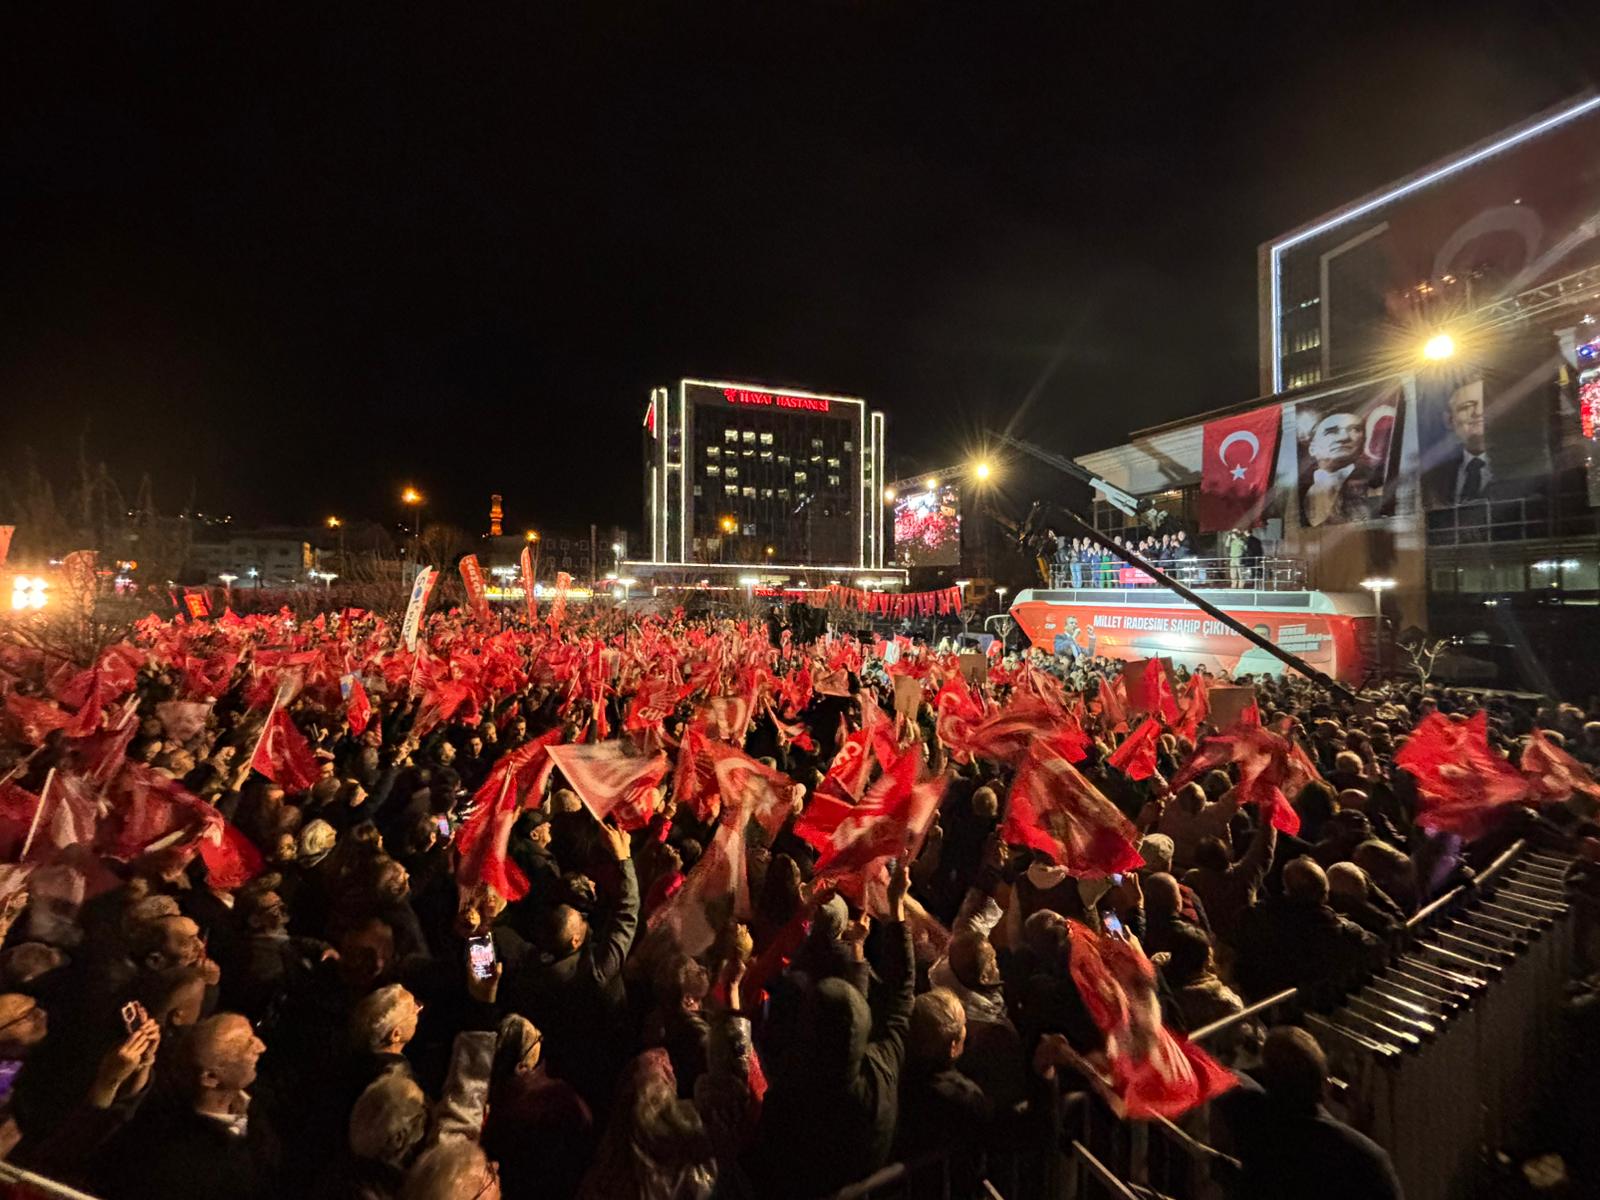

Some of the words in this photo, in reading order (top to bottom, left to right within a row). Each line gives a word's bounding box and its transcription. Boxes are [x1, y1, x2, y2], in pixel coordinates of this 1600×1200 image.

[1093, 615, 1122, 628] MİLLET
[1123, 616, 1169, 631] İRADESİNE
[1170, 618, 1201, 633] SAHİP
[637, 707, 667, 721] CHP
